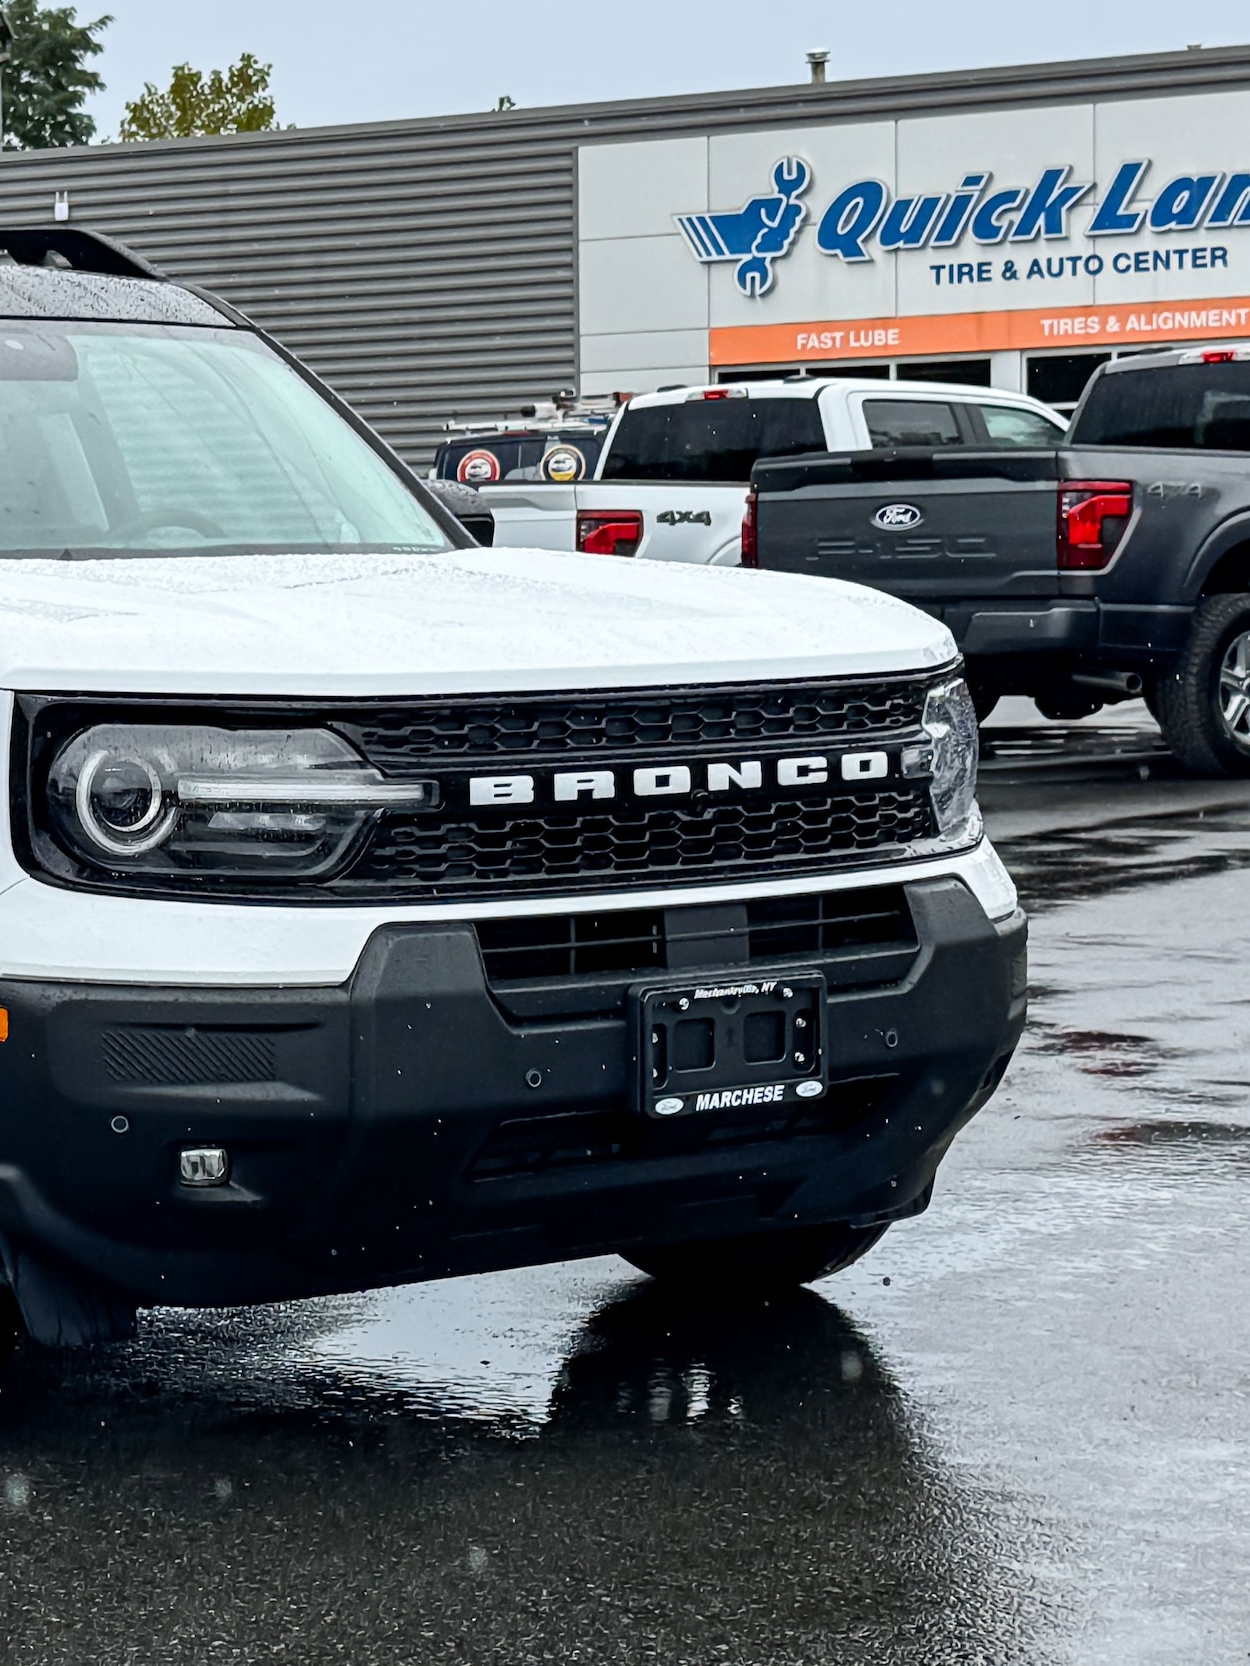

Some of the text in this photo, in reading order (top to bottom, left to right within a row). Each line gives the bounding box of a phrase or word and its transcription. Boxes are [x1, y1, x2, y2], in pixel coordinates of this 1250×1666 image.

[816, 165, 1094, 262] Quick
[930, 246, 1229, 285] TIRE & AUTO CENTER
[1040, 308, 1249, 336] TIRES & ALIGNMENT
[796, 327, 901, 351] FAST LUBE
[881, 506, 915, 525] Ford
[469, 751, 888, 806] BRONCO
[760, 981, 777, 993] NY
[695, 1084, 785, 1111] MARCHESE
